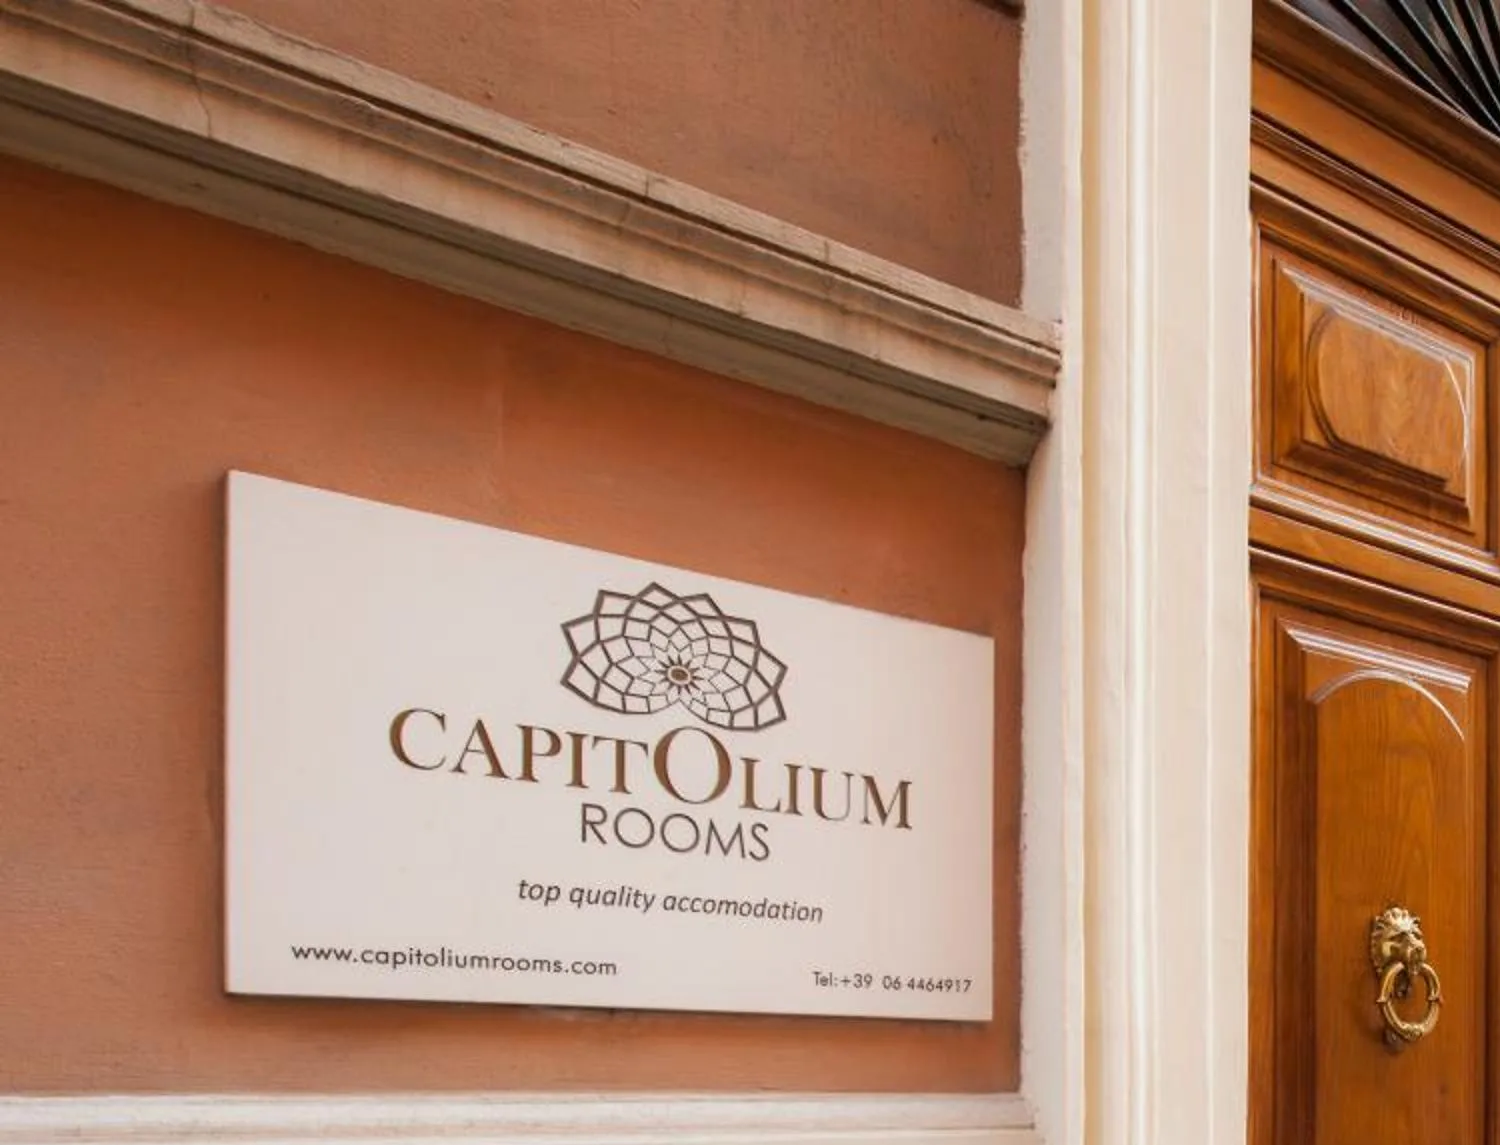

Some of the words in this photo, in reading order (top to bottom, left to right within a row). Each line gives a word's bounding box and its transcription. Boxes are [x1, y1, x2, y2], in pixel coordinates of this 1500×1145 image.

[389, 708, 912, 829] CAPITOLIUM
[581, 803, 769, 861] ROOMS
[518, 879, 560, 906] top
[569, 885, 656, 914] quality
[663, 893, 823, 923] accomodation
[289, 946, 617, 975] www.capitoliumrooms.com
[882, 975, 901, 991] 06
[907, 977, 972, 993] 4464917
